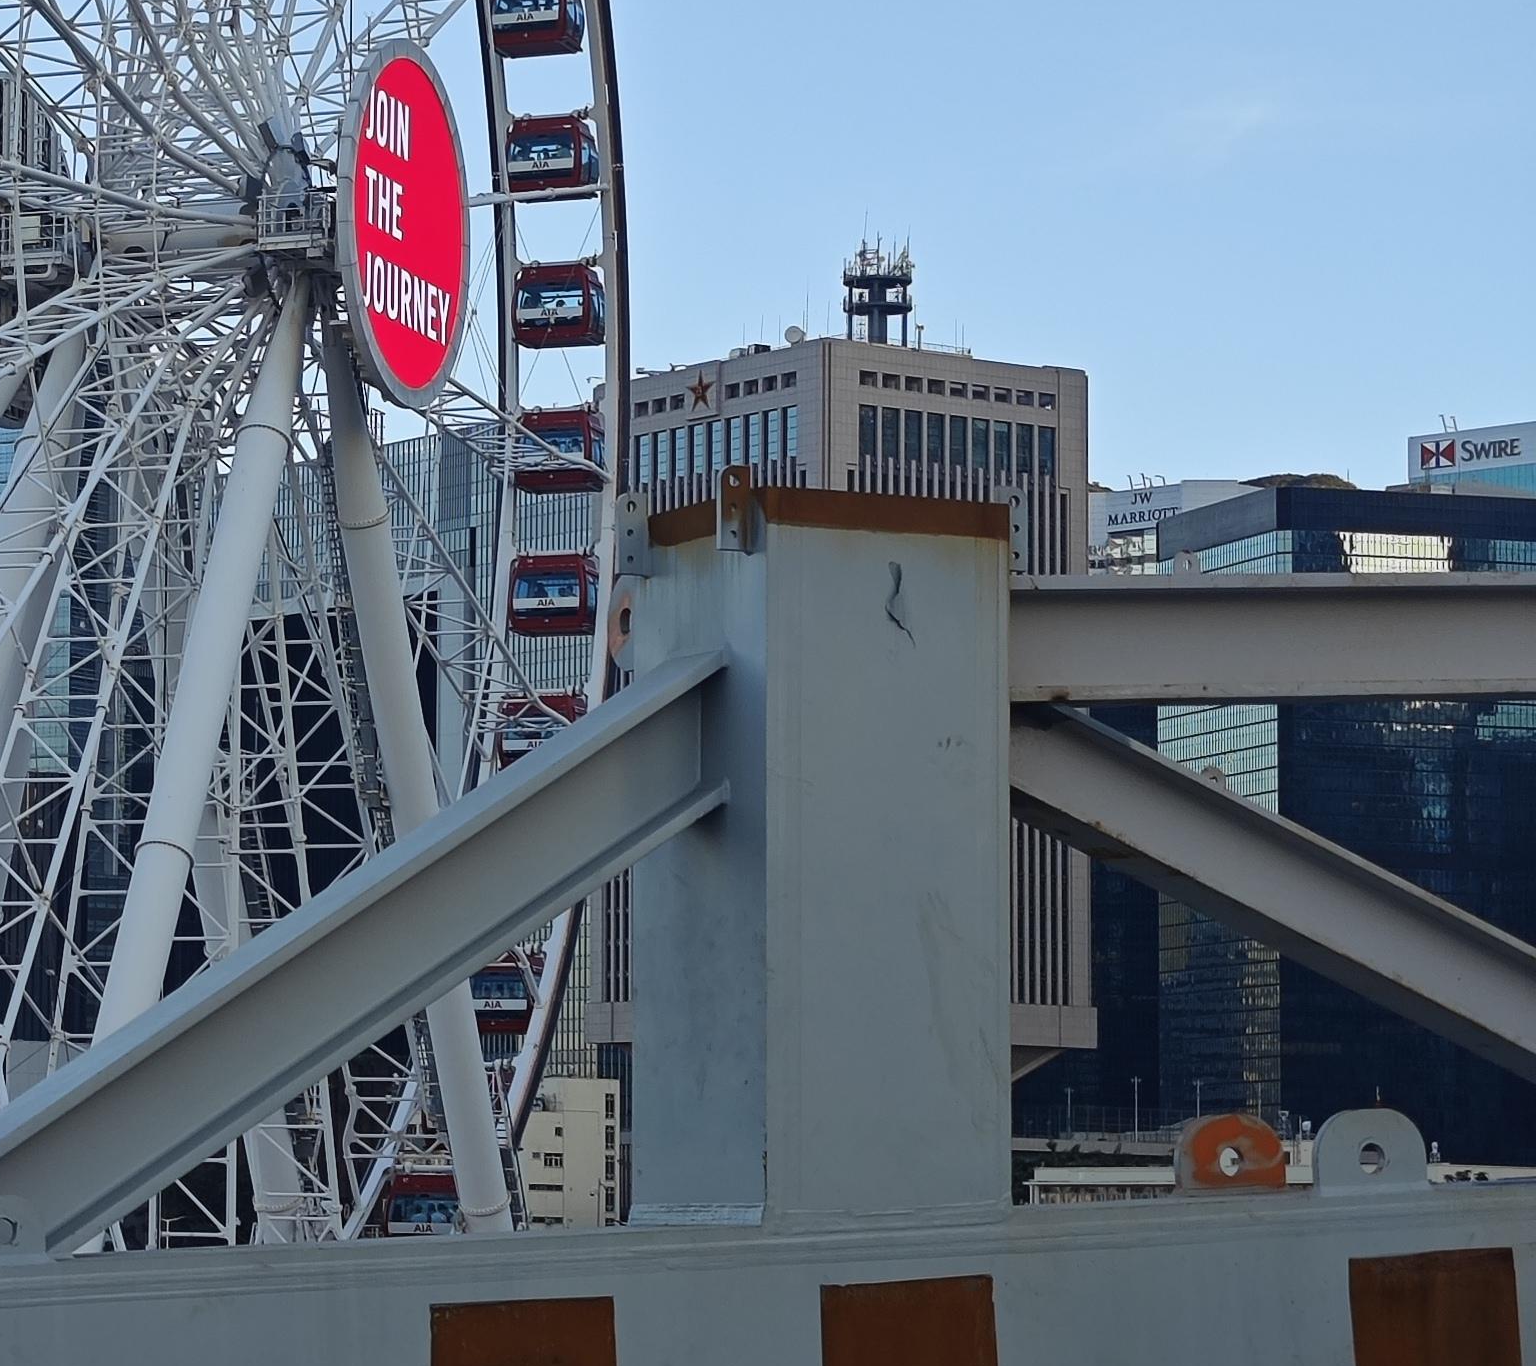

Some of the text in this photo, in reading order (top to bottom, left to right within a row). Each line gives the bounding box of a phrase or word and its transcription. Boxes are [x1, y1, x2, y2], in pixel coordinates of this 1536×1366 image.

[516, 12, 535, 22] AIA
[366, 83, 411, 161] JOIN
[531, 160, 550, 170] AIA
[365, 165, 404, 241] THE
[363, 251, 451, 347] JOURNEY
[540, 307, 559, 317] AIA
[1461, 438, 1521, 462] SWIRE
[1131, 492, 1153, 505] JW
[1108, 506, 1178, 526] MARRIOTT
[536, 599, 555, 607] AIA
[483, 1001, 503, 1009] AIA
[413, 1224, 434, 1234] AIA
